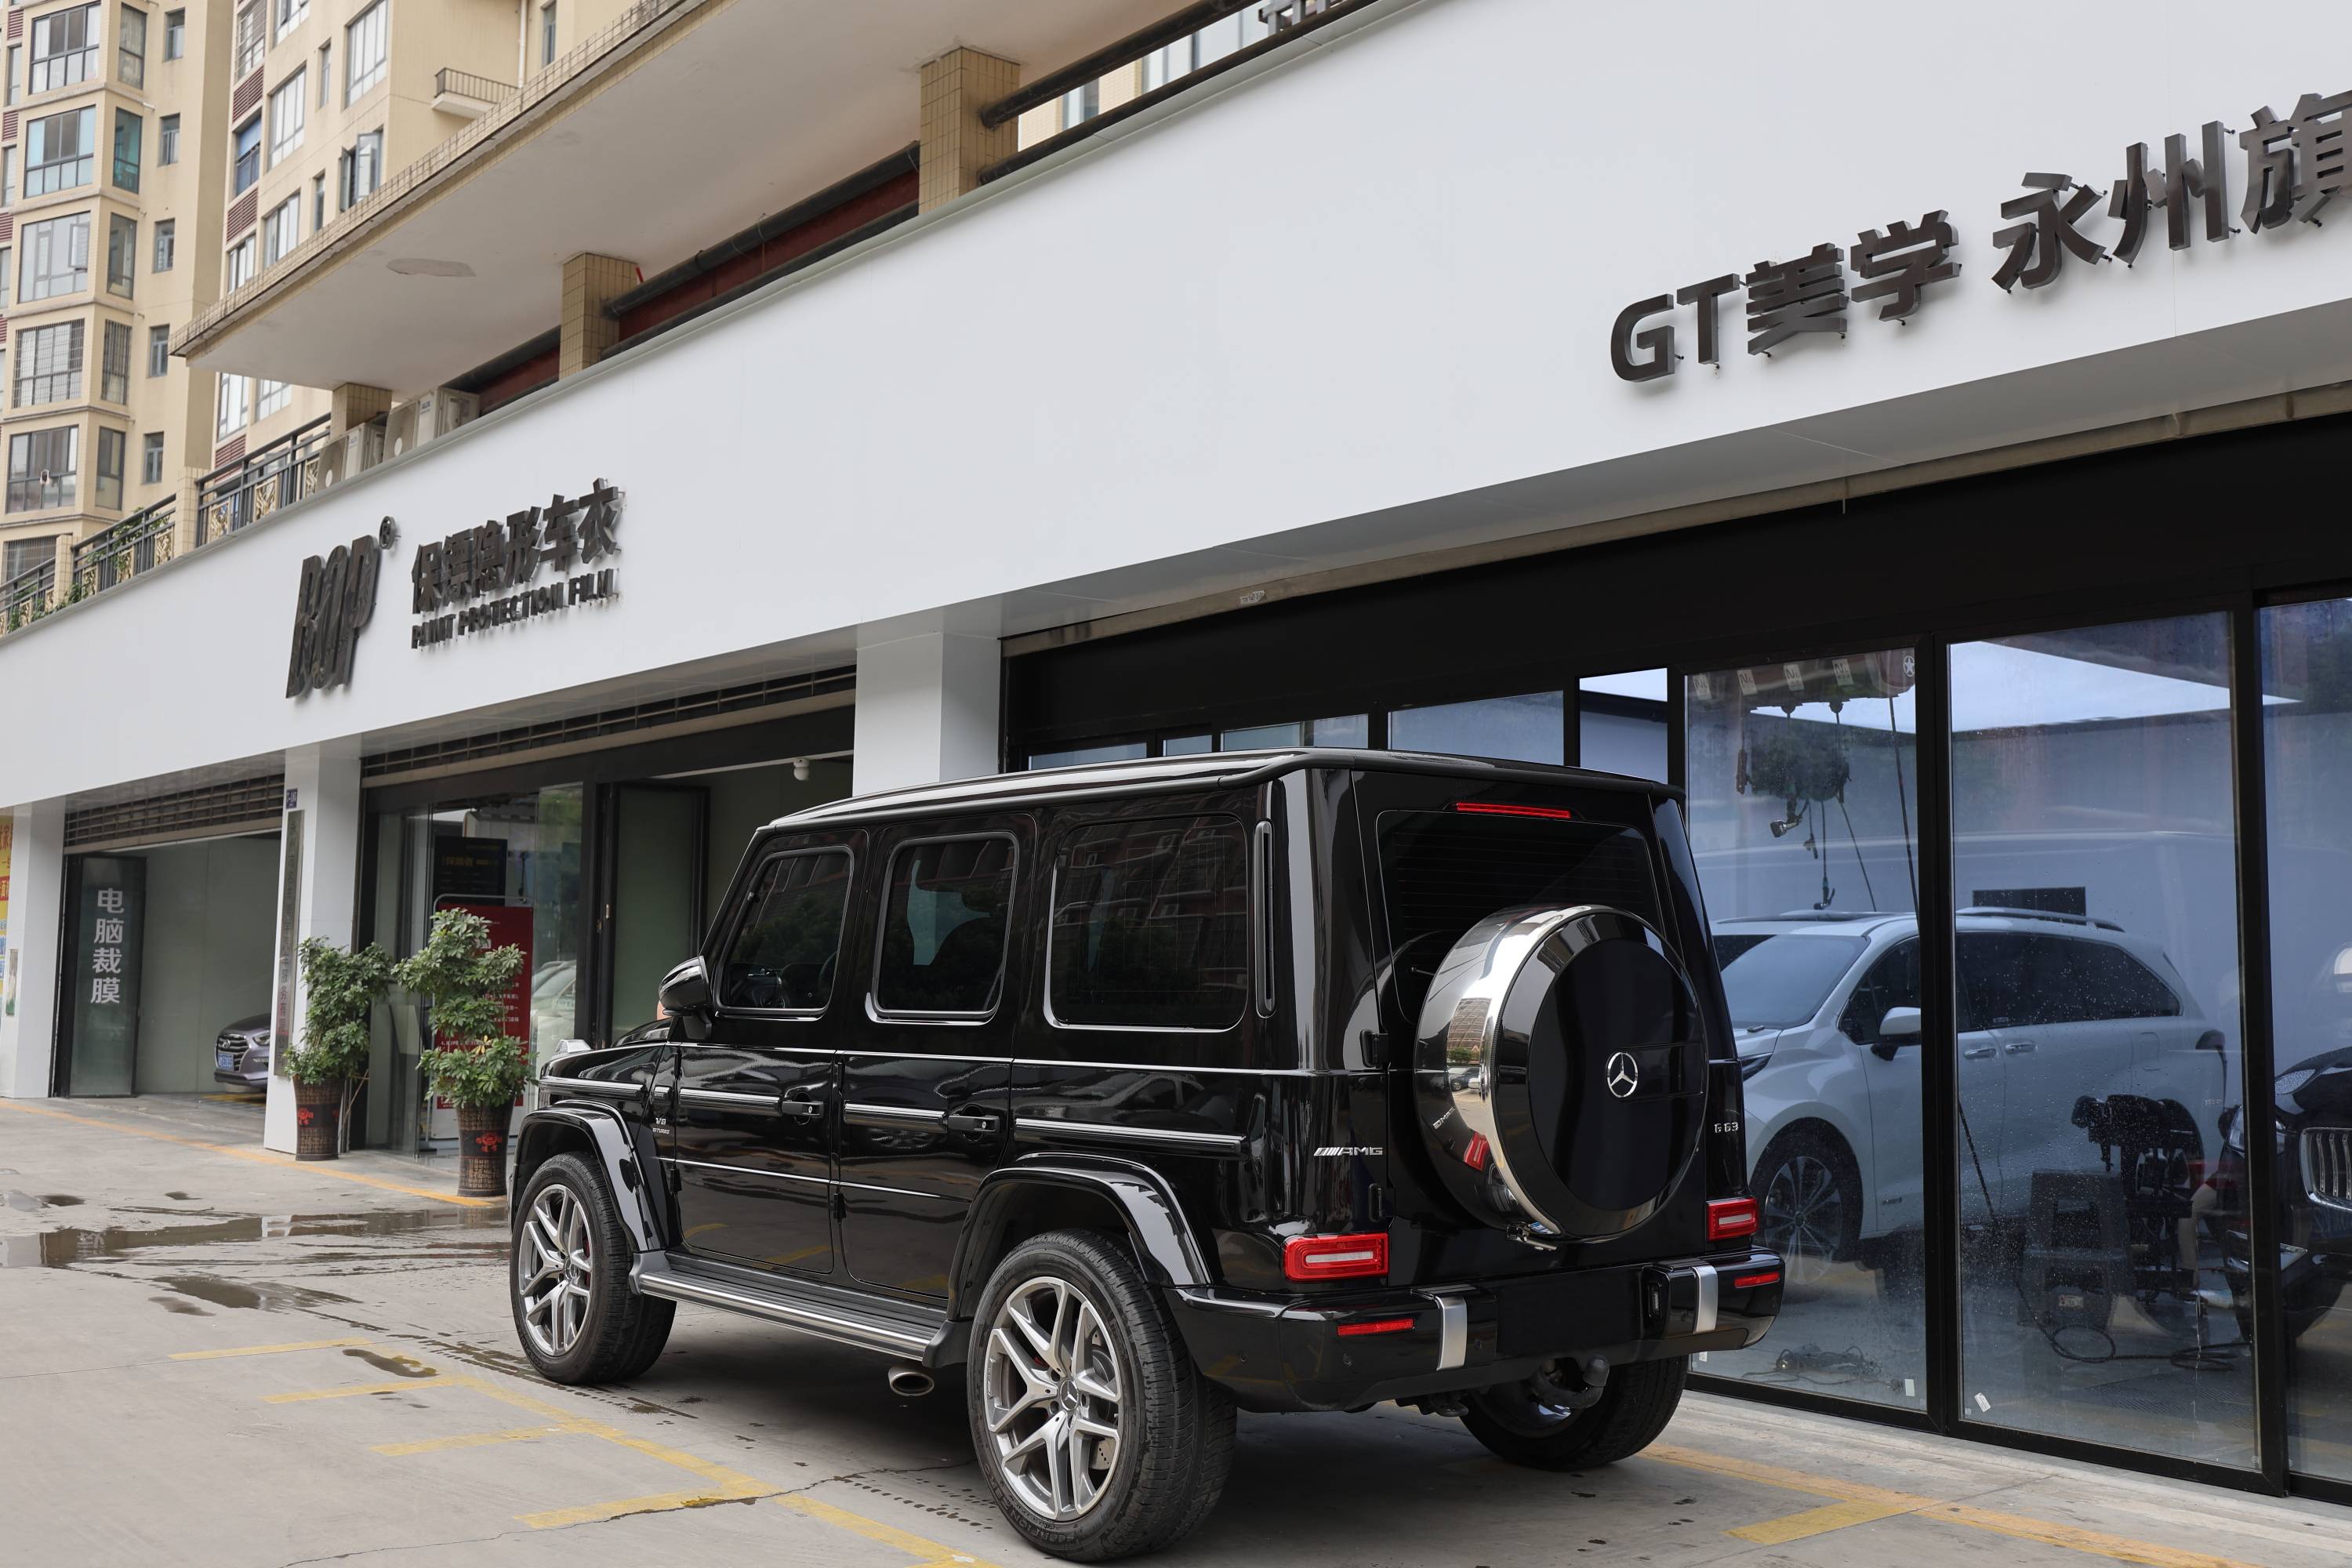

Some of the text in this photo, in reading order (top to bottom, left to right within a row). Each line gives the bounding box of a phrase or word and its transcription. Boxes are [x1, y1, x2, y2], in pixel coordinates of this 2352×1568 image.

[1610, 88, 2352, 383] GT美学 永州旗
[411, 568, 615, 649] PAINT PROTECTION FILM
[90, 887, 125, 1004] 电脑裁膜
[1336, 1146, 1383, 1156] AMG
